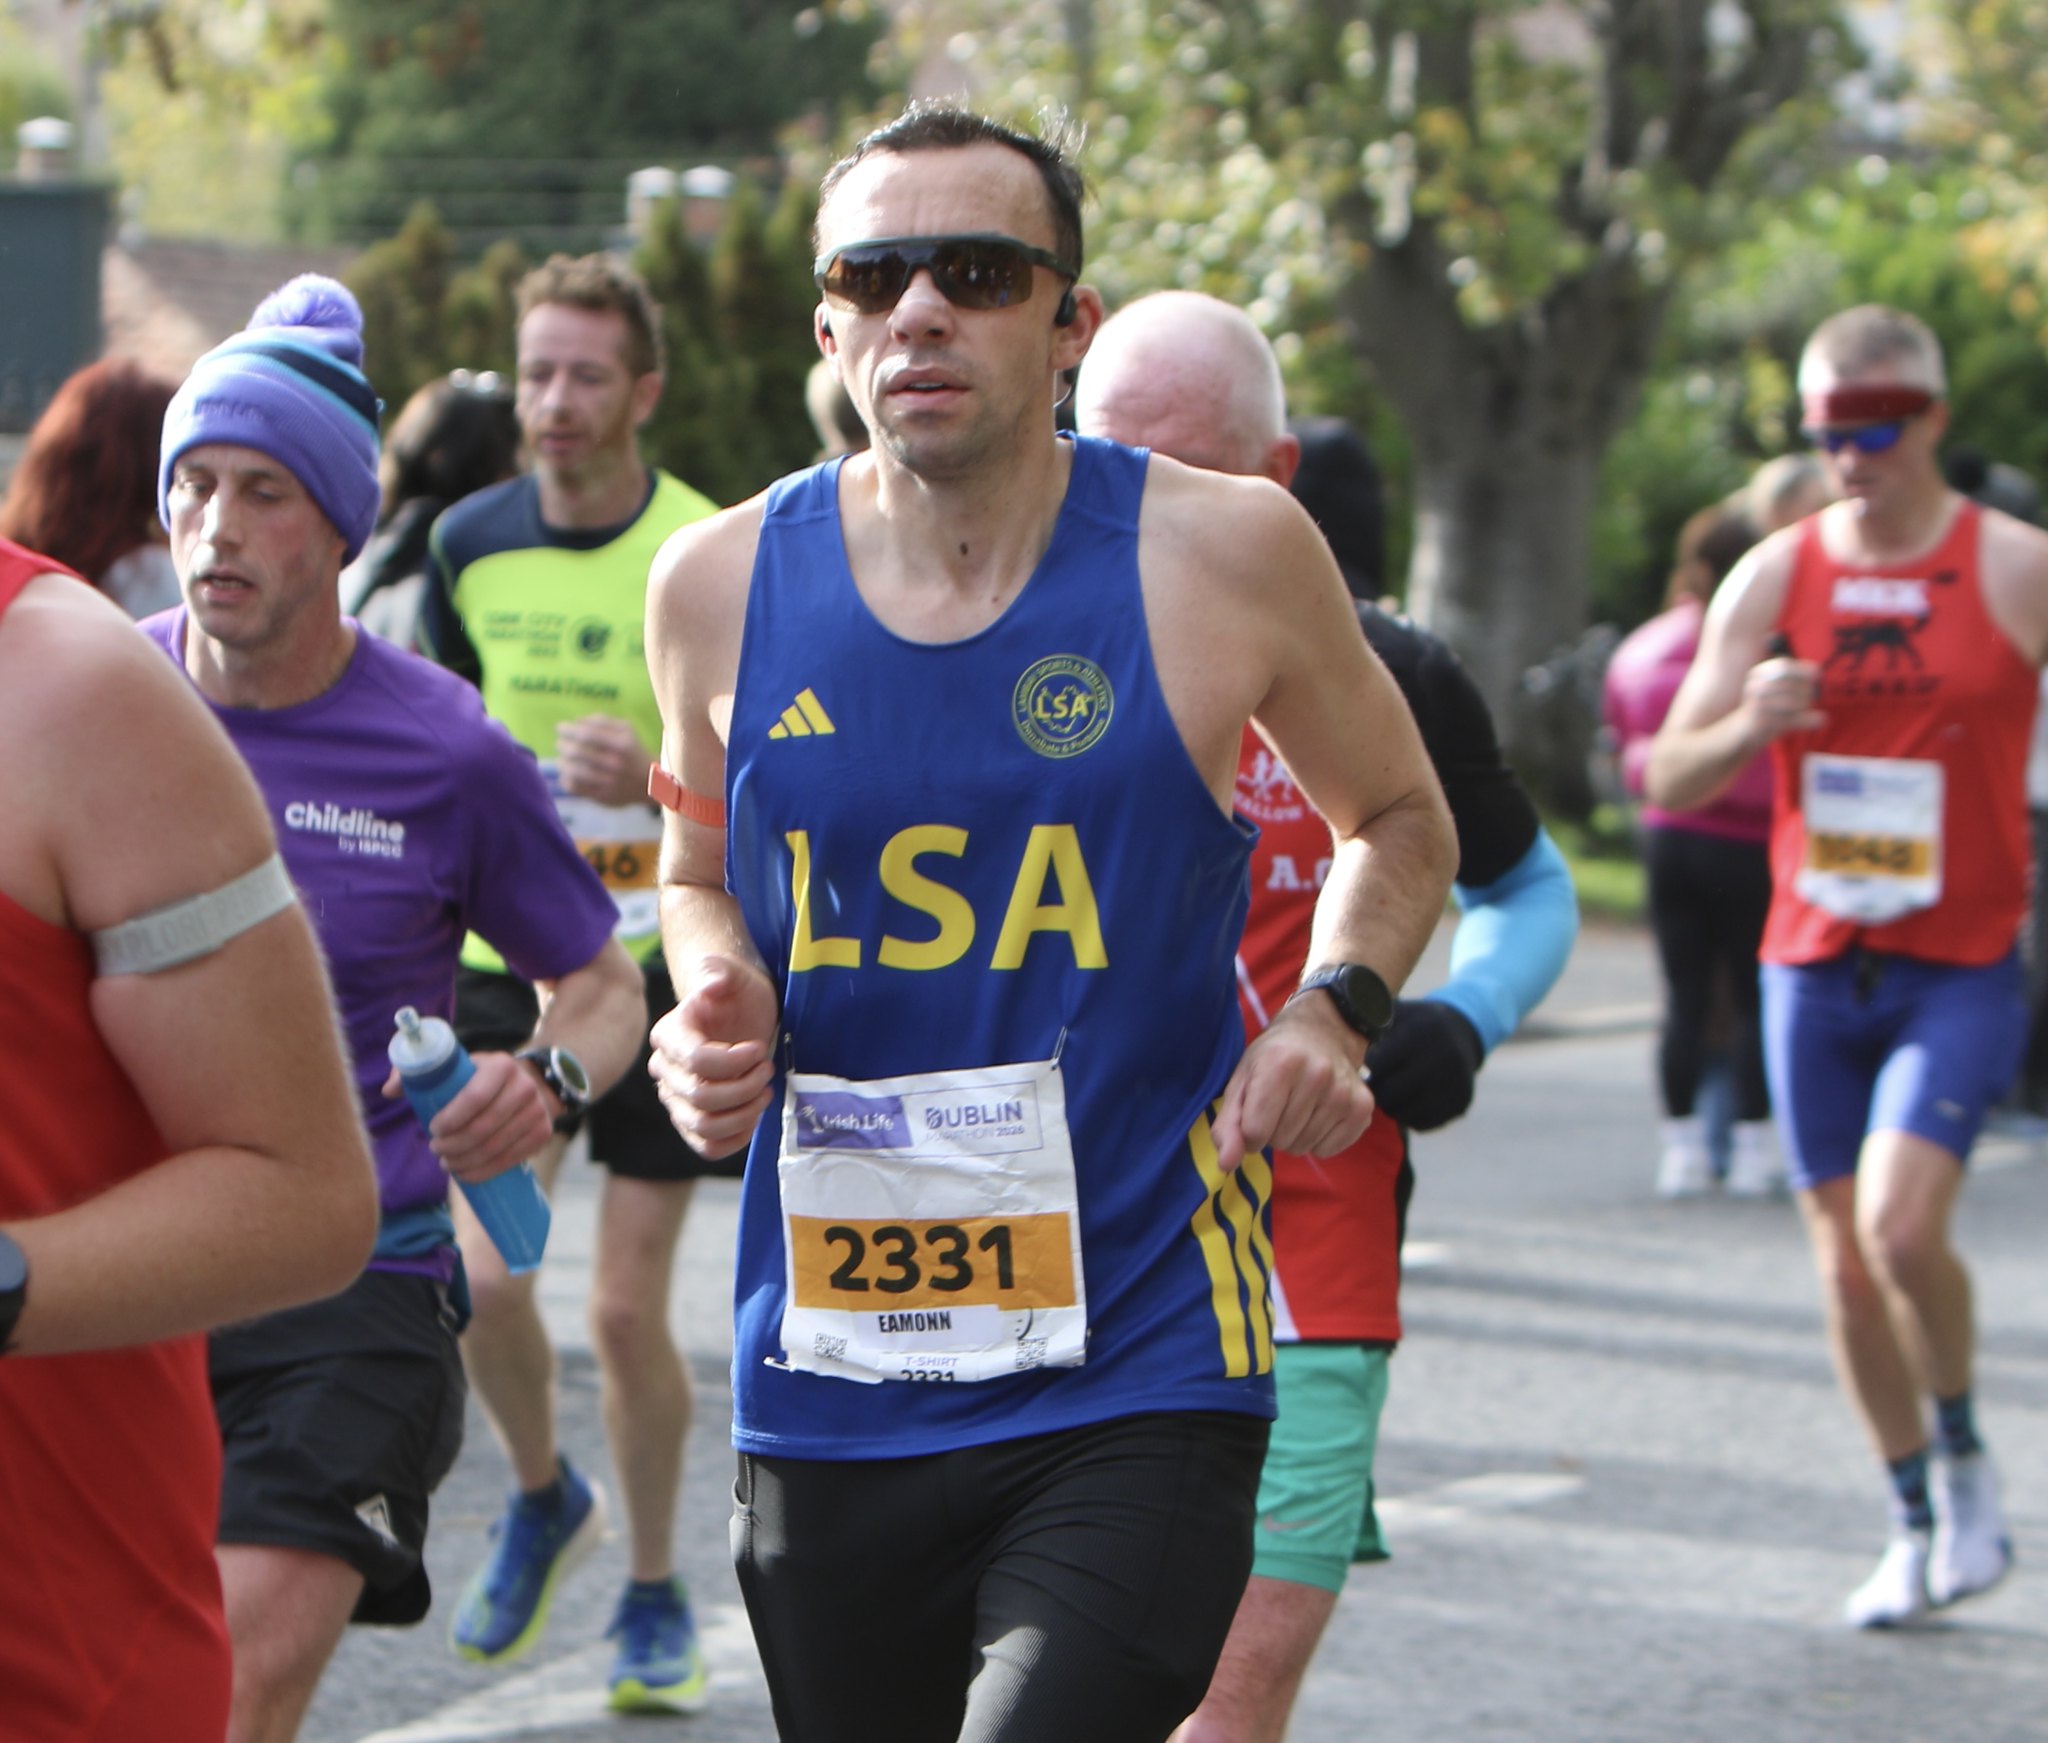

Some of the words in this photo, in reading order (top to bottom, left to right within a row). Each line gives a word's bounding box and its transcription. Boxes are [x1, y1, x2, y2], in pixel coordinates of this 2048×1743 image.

[1035, 693, 1089, 720] LSA
[285, 800, 404, 842] Childline
[337, 835, 355, 854] by
[358, 837, 401, 858] ISPCC
[785, 823, 1109, 973] LSA
[822, 1112, 860, 1130] Irish
[863, 1112, 894, 1131] Life
[925, 1100, 1022, 1130] DUBLIN
[823, 1225, 1014, 1293] 2331
[879, 1311, 952, 1334] EAMONN
[905, 1356, 960, 1367] T-SHIRT
